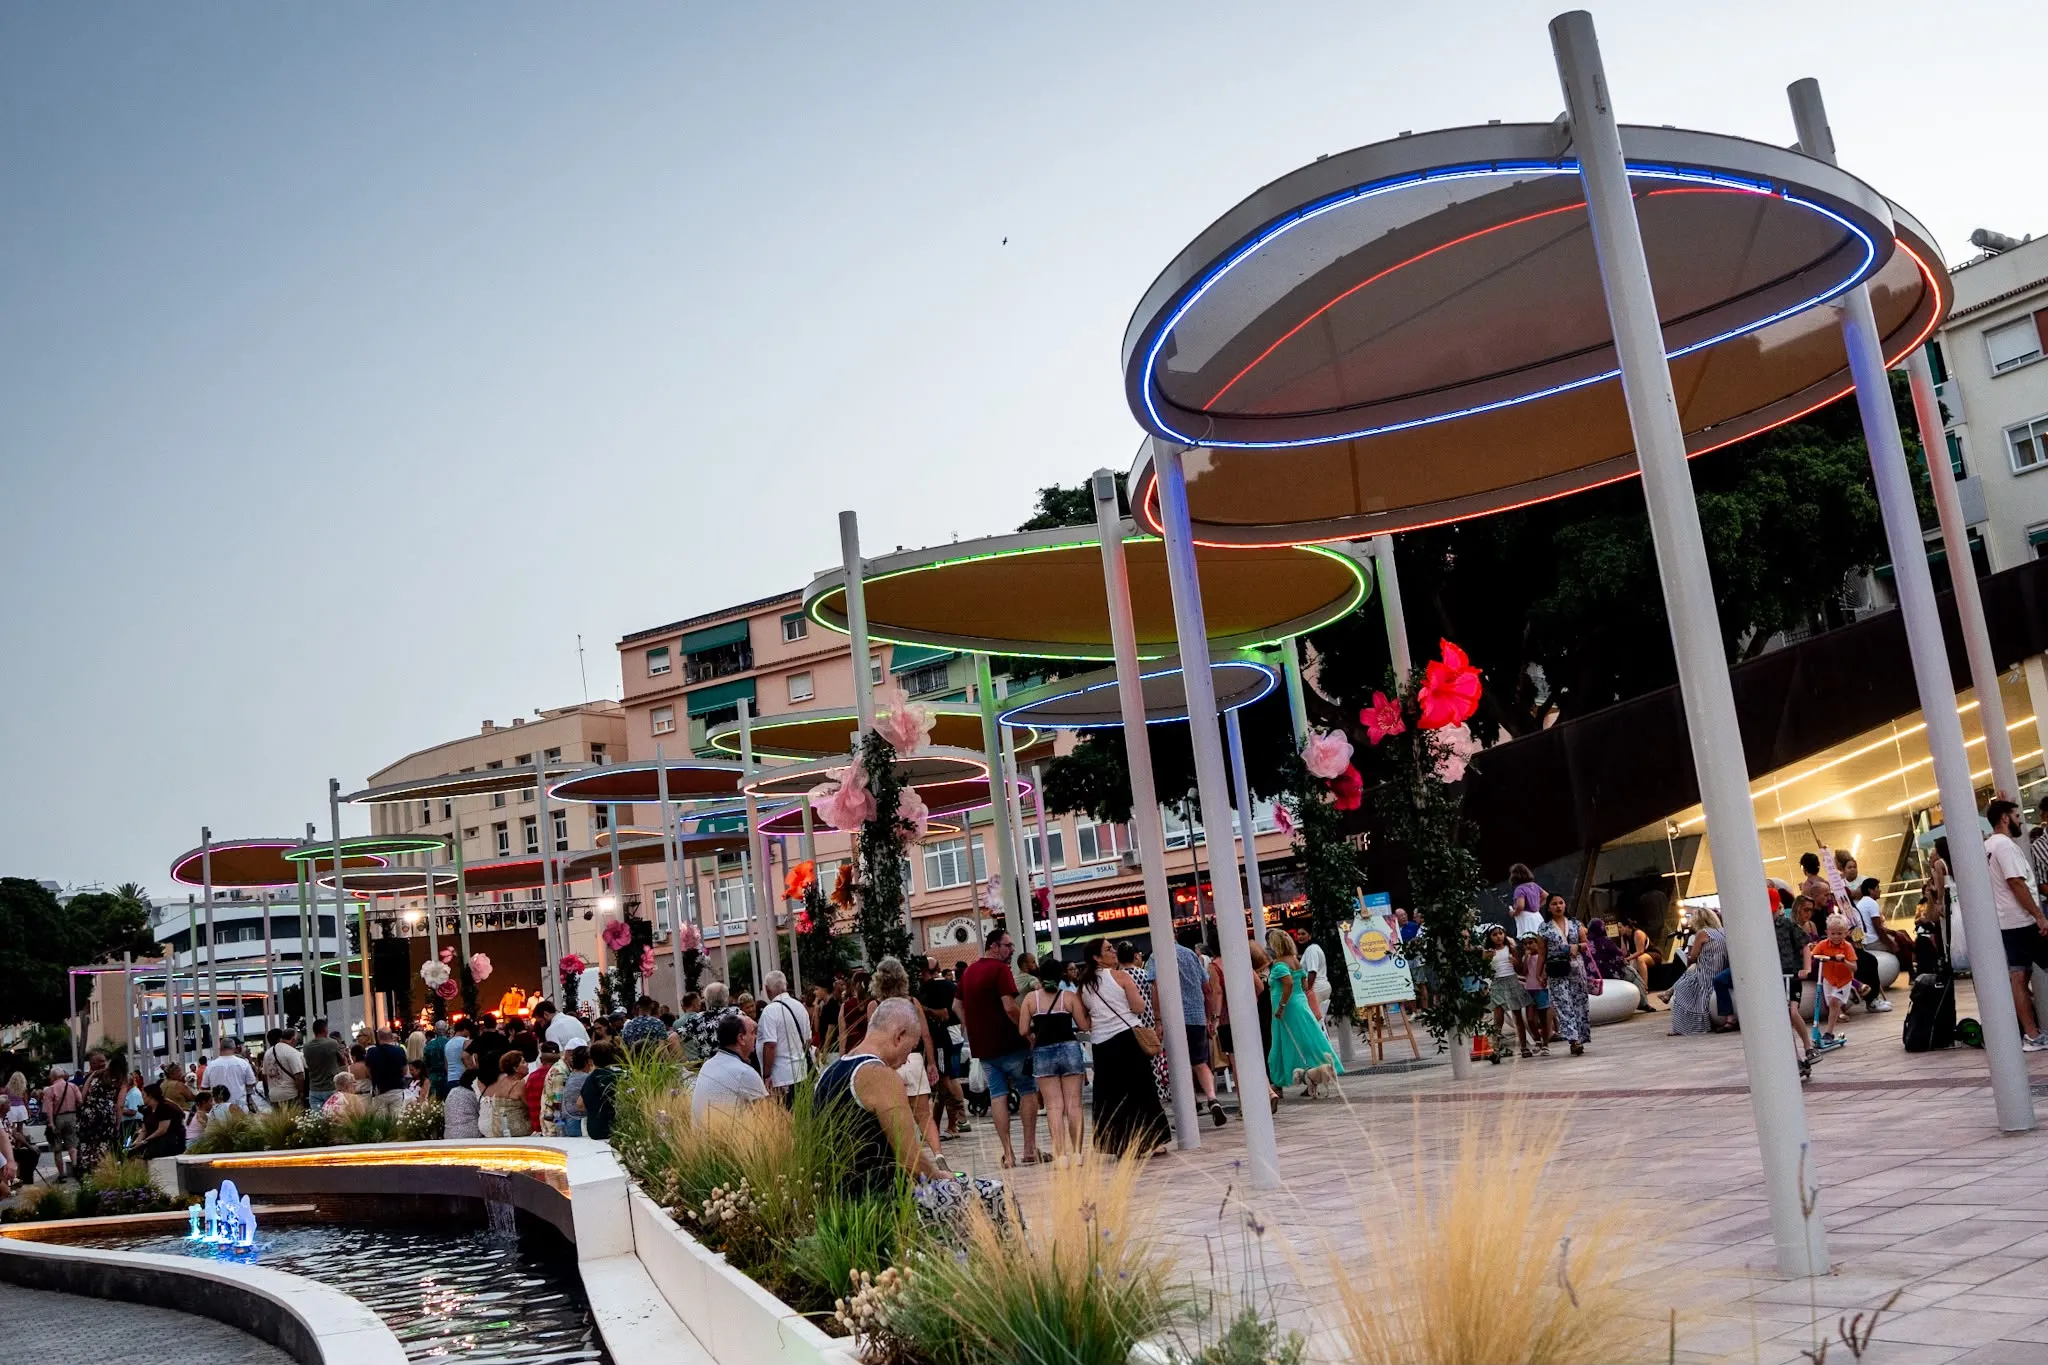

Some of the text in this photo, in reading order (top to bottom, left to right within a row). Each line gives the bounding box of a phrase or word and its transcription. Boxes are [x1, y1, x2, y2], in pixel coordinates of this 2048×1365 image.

[1033, 904, 1149, 931] ESTURANTE SUSHI RAM
